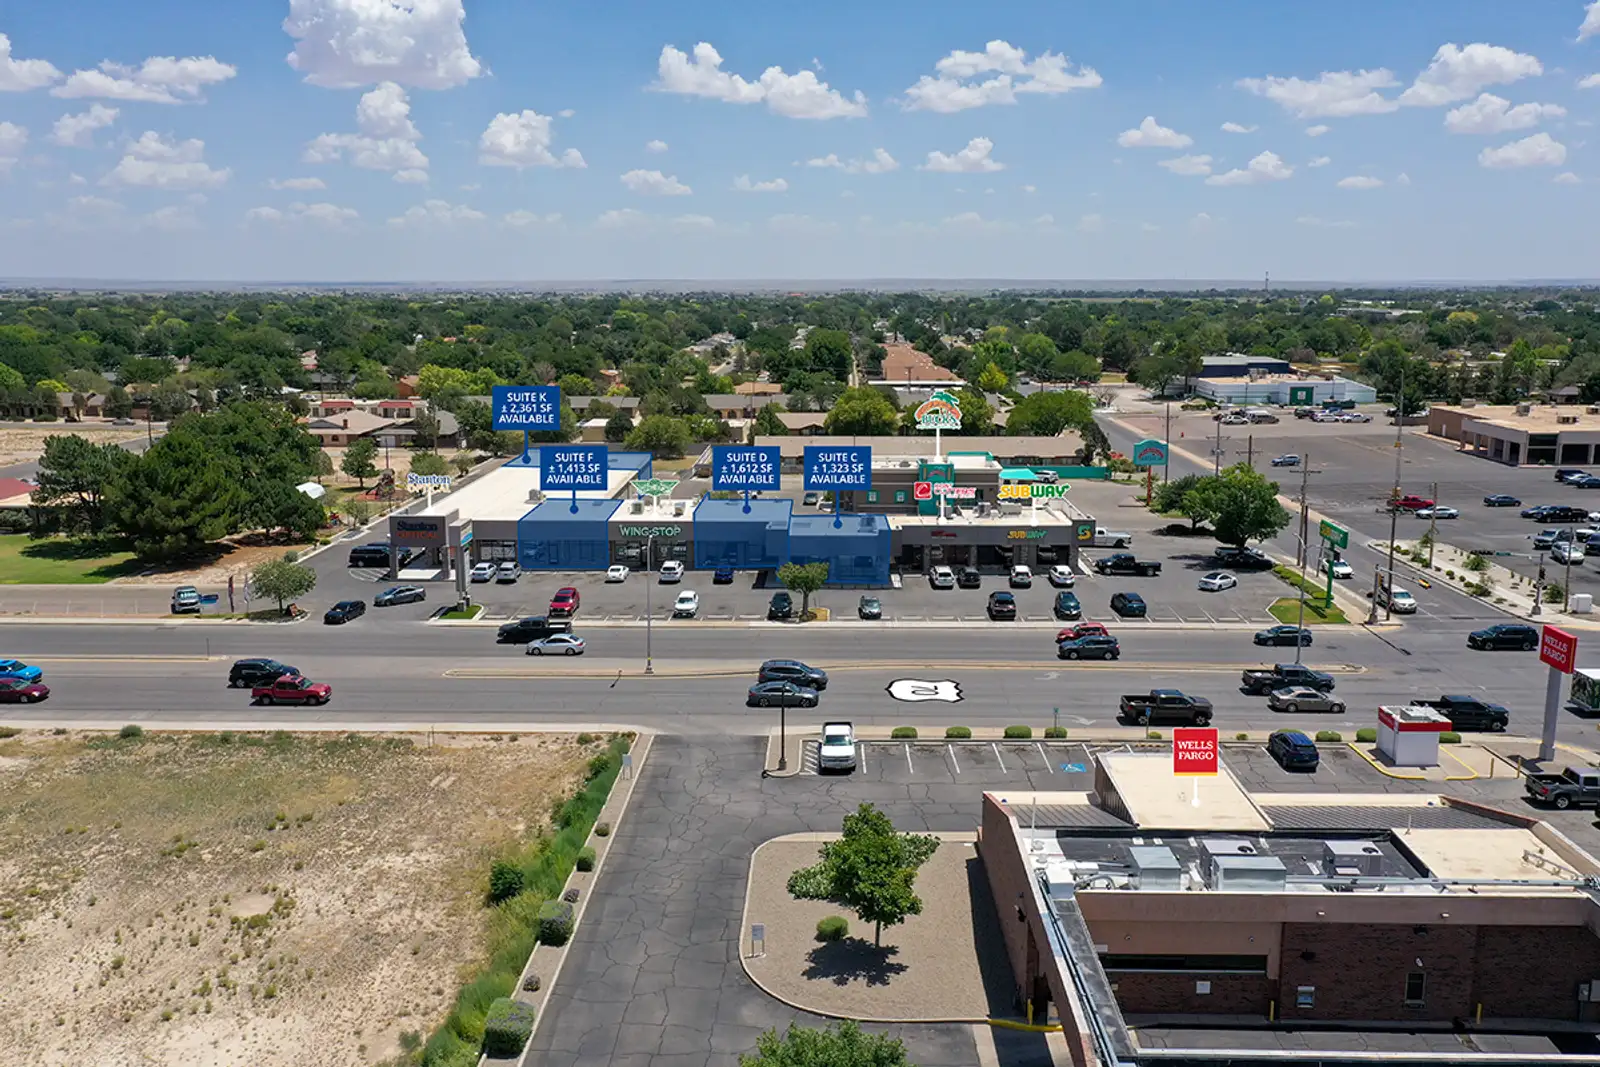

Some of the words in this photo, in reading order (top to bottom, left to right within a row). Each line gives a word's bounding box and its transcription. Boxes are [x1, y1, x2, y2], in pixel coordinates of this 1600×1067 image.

[397, 521, 438, 531] Stanton
[1544, 634, 1568, 652] WELLS
[1544, 646, 1567, 664] FARGO
